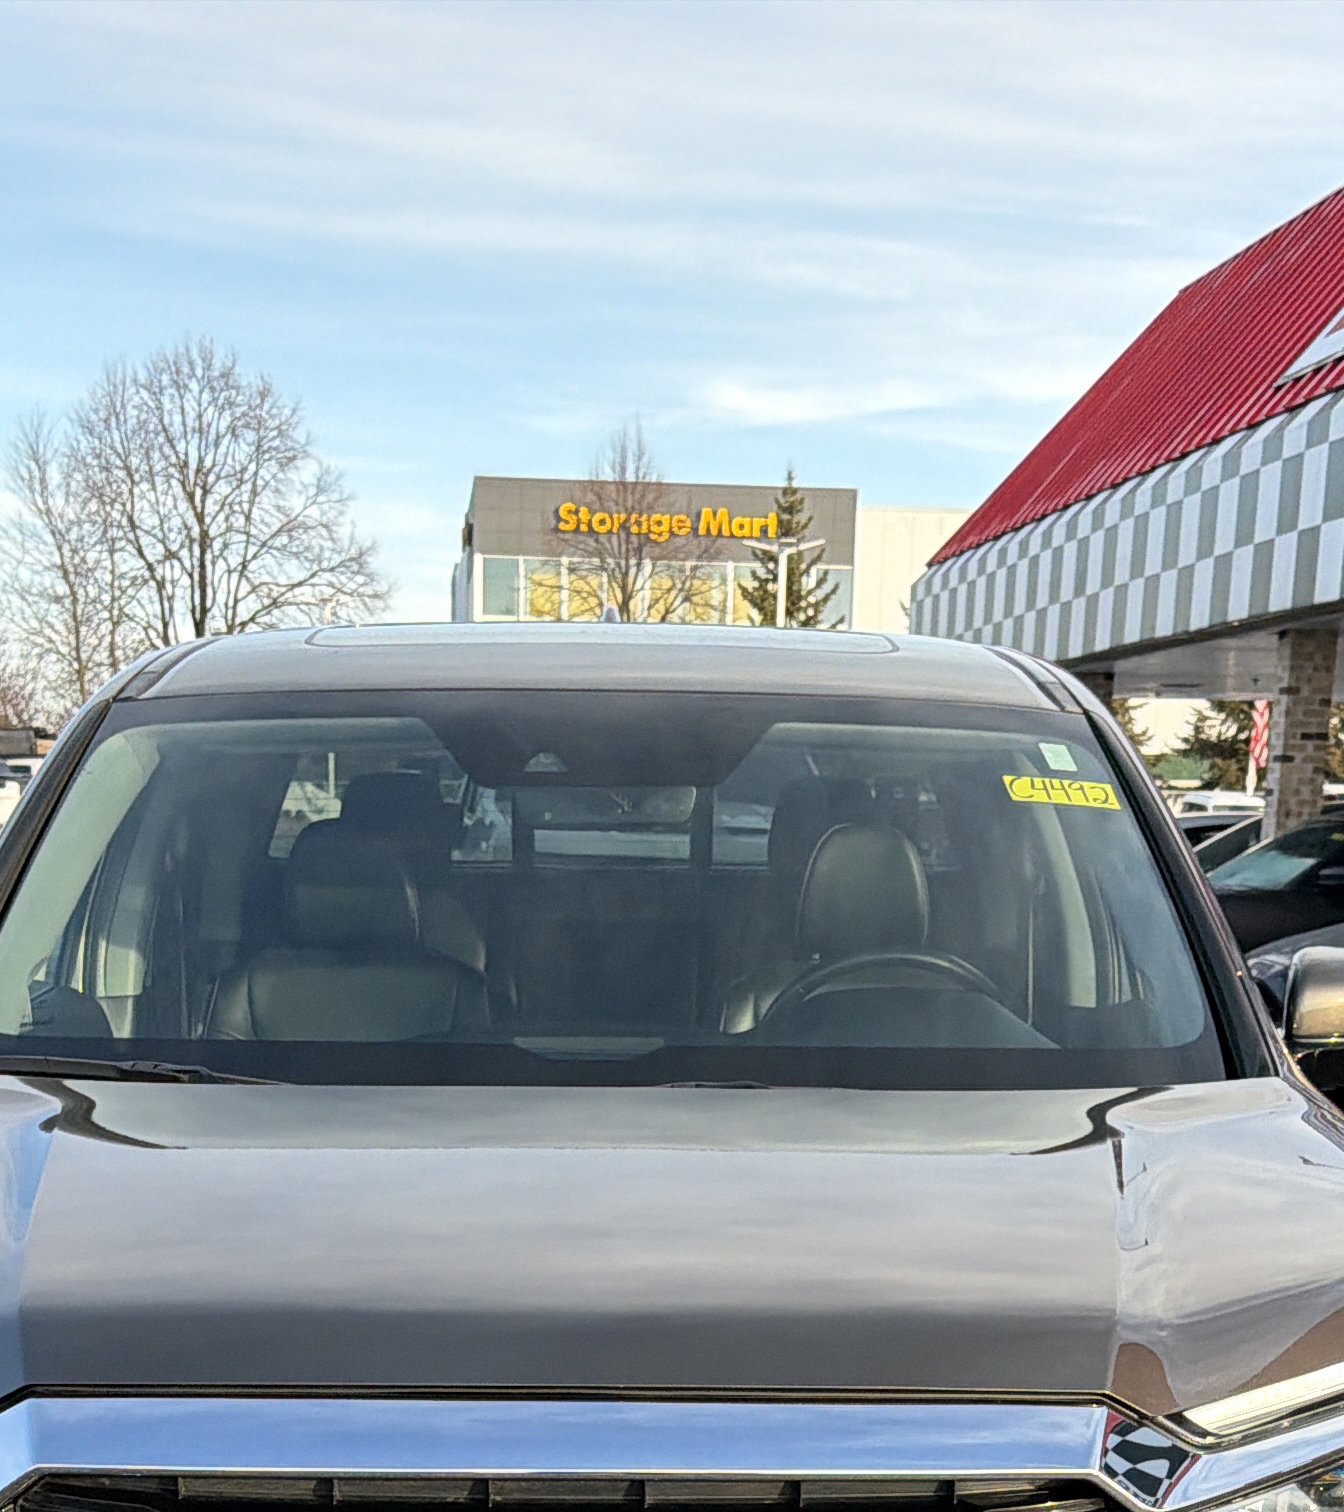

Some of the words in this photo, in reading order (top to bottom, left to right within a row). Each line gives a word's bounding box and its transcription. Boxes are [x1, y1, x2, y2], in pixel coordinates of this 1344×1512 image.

[558, 501, 692, 542] Storage
[698, 507, 778, 538] Mart
[1009, 776, 1115, 805] C4492
